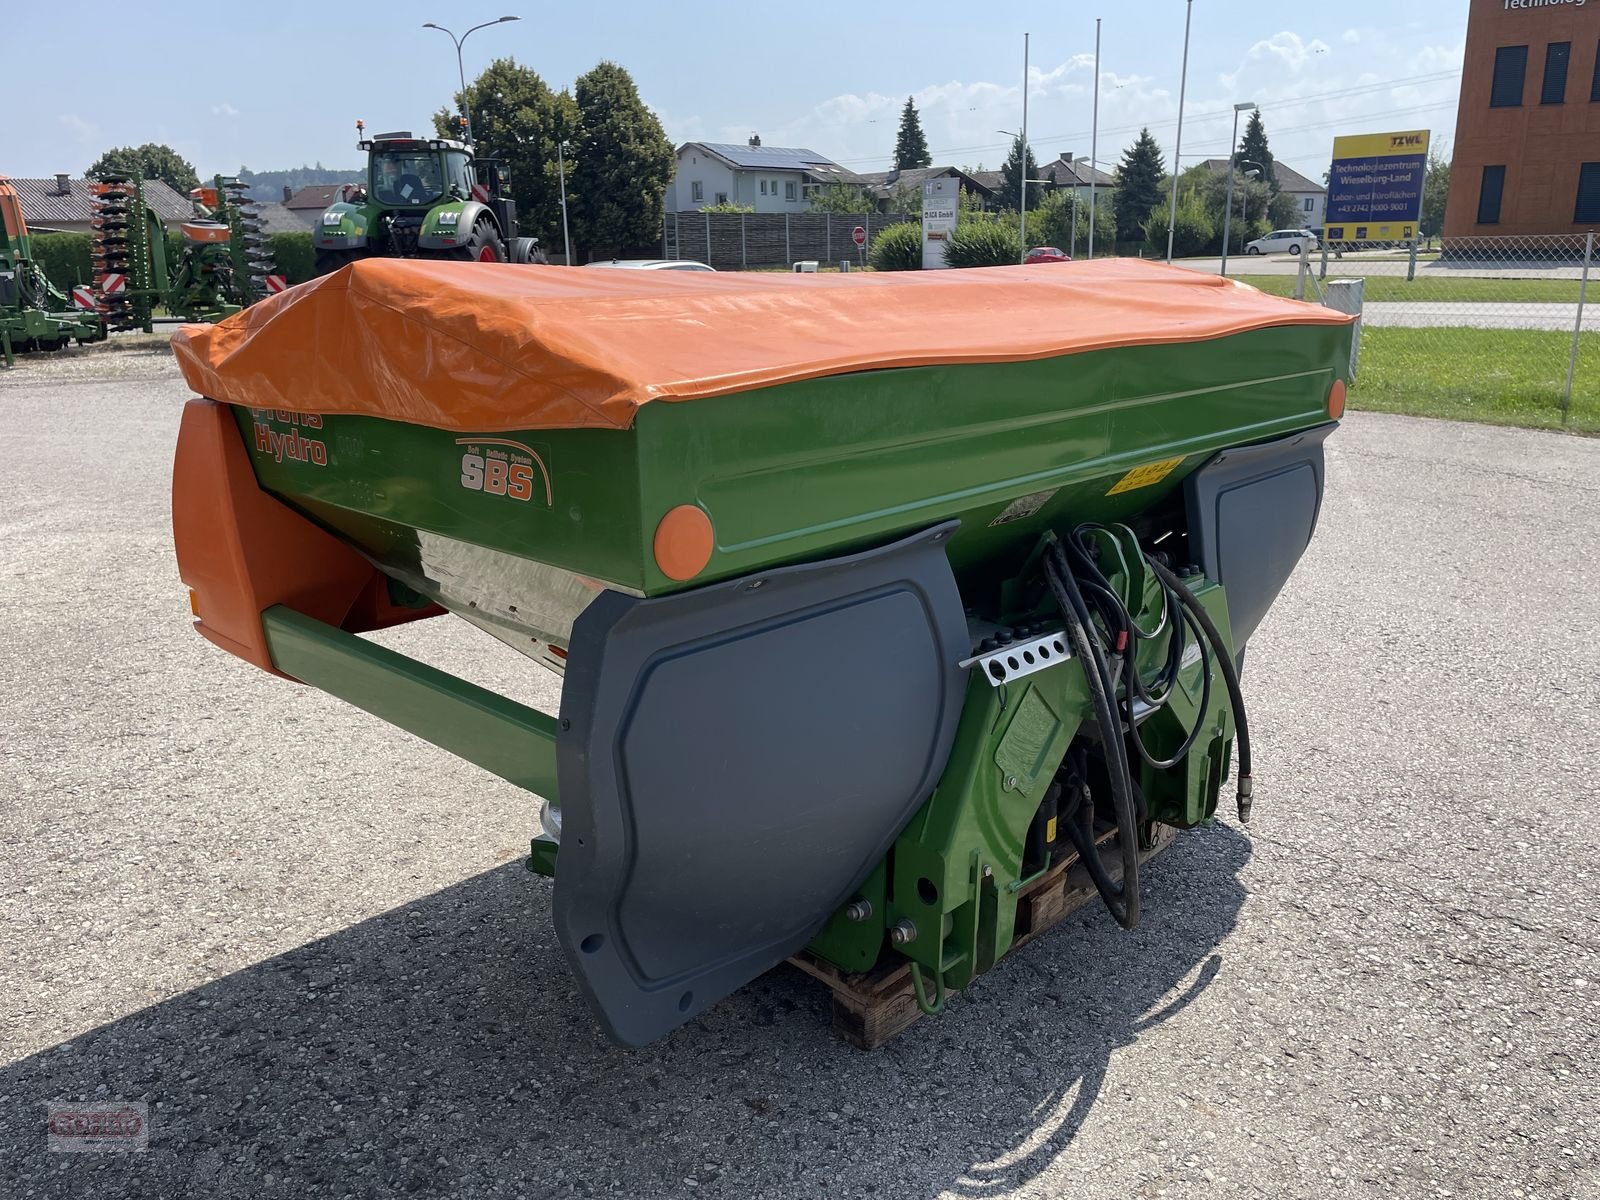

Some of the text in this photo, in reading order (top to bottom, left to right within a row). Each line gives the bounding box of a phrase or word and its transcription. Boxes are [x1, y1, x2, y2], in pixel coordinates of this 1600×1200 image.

[1335, 161, 1420, 174] Technologiezentrum
[1341, 173, 1412, 185] Wieselburg-Land
[1332, 192, 1354, 202] Labor-
[1356, 191, 1370, 201] und
[254, 422, 328, 466] Hydro
[461, 453, 534, 501] SBS
